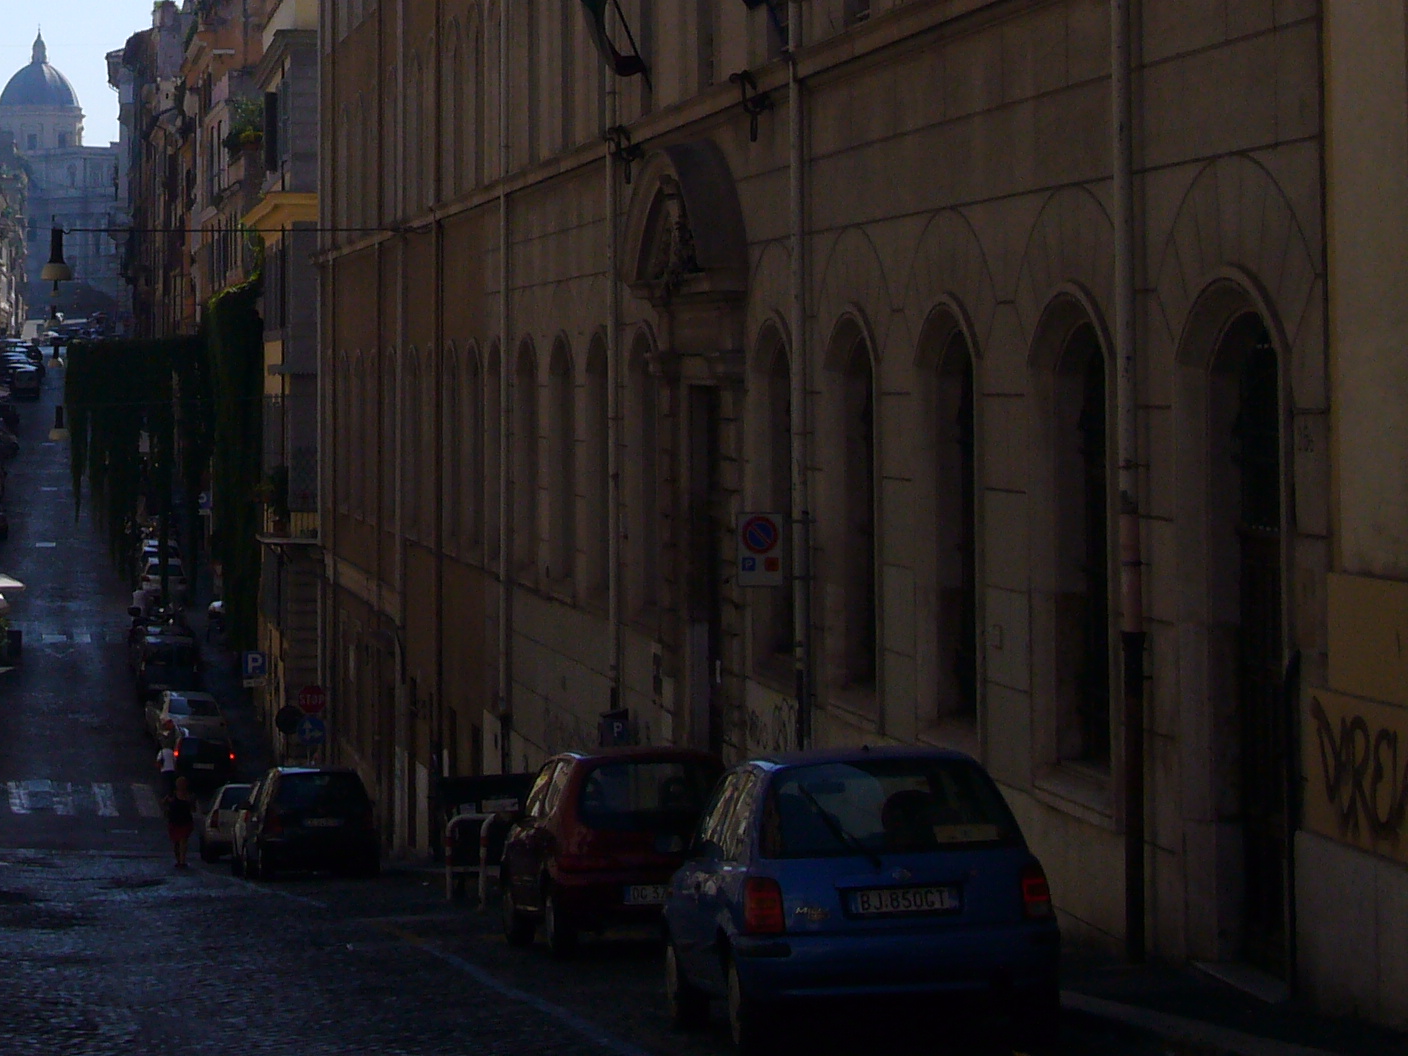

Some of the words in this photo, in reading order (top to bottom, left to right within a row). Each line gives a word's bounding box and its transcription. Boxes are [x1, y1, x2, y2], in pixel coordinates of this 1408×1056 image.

[248, 654, 262, 673] P
[299, 694, 325, 704] STOP
[613, 722, 623, 737] P
